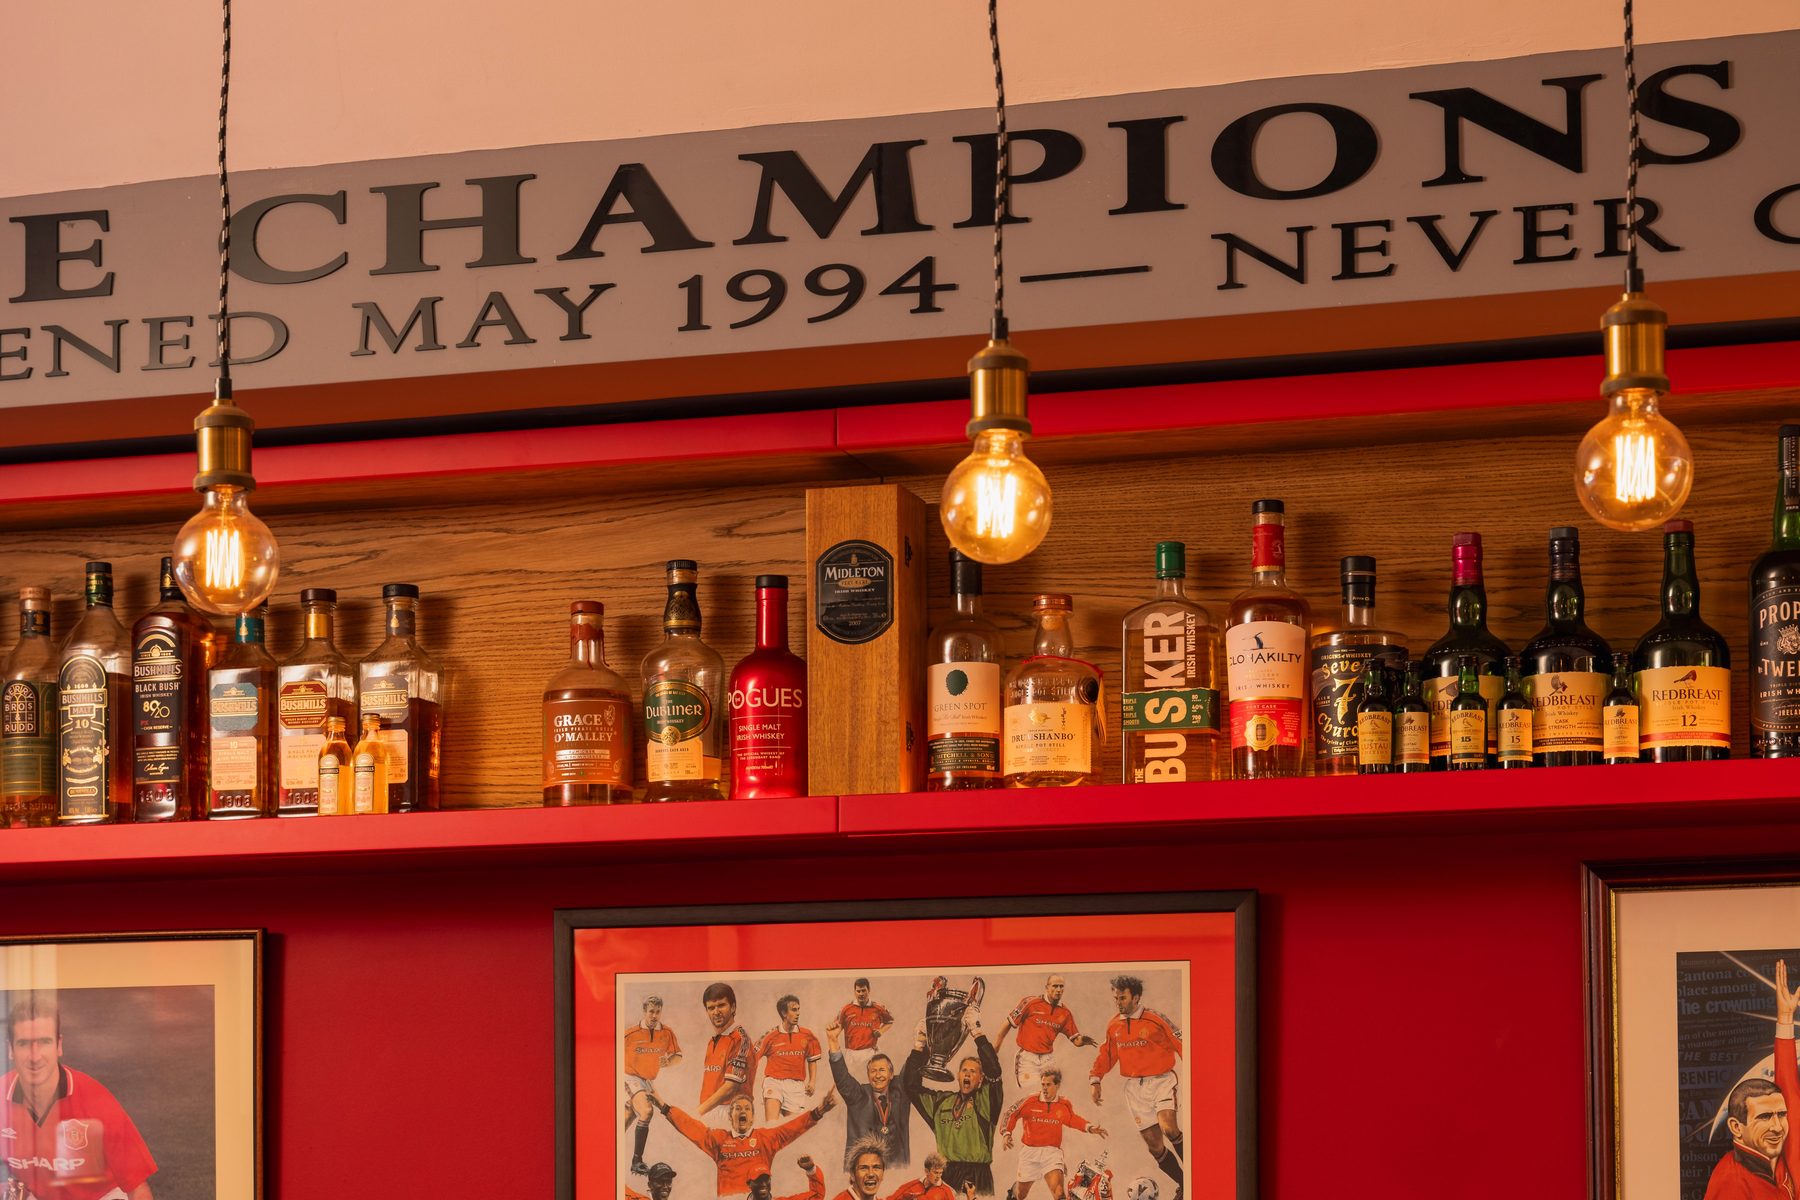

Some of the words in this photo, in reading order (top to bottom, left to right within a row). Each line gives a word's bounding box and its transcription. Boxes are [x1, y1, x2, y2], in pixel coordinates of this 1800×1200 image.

[219, 59, 1743, 285] CHAMPIONS
[350, 283, 616, 357] MAY
[677, 256, 957, 332] 1994
[1211, 198, 1682, 290] NEVER
[824, 566, 884, 581] MIDLETON
[1186, 612, 1196, 651] WHISKEY
[134, 664, 181, 677] BUSHMILLS
[1186, 653, 1196, 679] IRISH
[135, 683, 157, 693] BLACK
[159, 682, 179, 691] BUSH
[1760, 689, 1782, 699] IRISH
[62, 693, 104, 705] BUSHMILLS
[361, 693, 407, 706] BUSHMILLS
[727, 687, 803, 712] POGUES
[1144, 611, 1187, 783] BUSKER
[1332, 675, 1360, 725] 7
[1530, 694, 1599, 708] REDBREAST
[1652, 688, 1723, 702] REDBREAST
[5, 702, 33, 712] BROS
[72, 706, 92, 715] MALT
[211, 700, 257, 713] BUSHMILLS
[280, 697, 327, 711] BUSHMILLS
[934, 702, 961, 713] GREEN
[963, 701, 987, 711] SPOT
[75, 720, 89, 729] 10
[554, 714, 603, 728] GRACE
[1680, 714, 1697, 727] 12
[5, 723, 34, 732] RUDD
[738, 724, 760, 732] SINGLE
[762, 723, 781, 731] MALT
[554, 731, 613, 743] O'MALLEY
[1011, 733, 1074, 743] DRUSHANBO
[1460, 735, 1472, 743] 15
[1511, 735, 1521, 743] 15
[1135, 768, 1144, 783] THE
[721, 1150, 760, 1158] SHARP
[8, 1156, 85, 1171] SHARP
